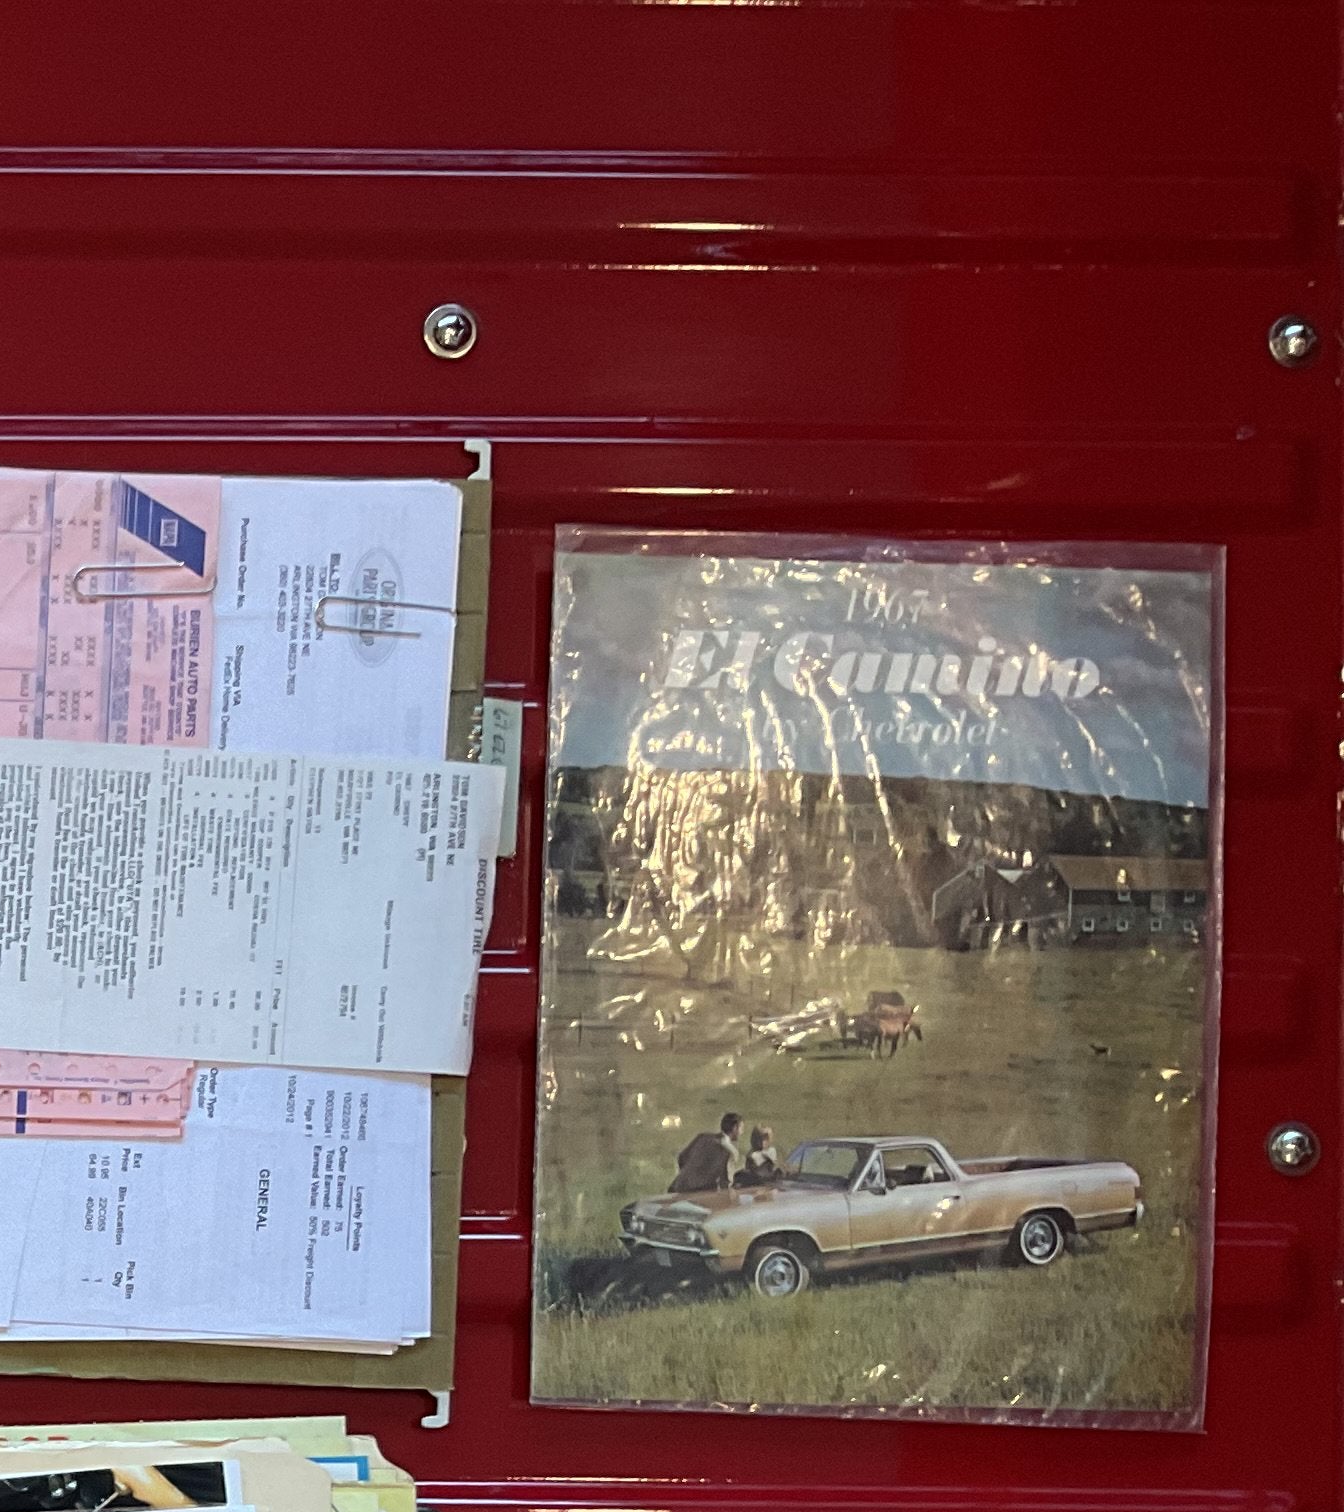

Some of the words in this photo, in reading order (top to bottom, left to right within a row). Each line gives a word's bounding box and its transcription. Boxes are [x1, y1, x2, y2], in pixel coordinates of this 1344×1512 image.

[239, 518, 250, 562] Purchase
[238, 565, 248, 592] Order
[842, 588, 930, 624] 1967
[189, 610, 201, 657] BURIEN
[187, 661, 199, 694] AUTO
[232, 645, 245, 687] Shipping
[663, 629, 760, 689] El
[773, 629, 1101, 699] Camino
[184, 698, 197, 738] PARTS
[217, 715, 230, 751] Delivery
[473, 858, 488, 923] DISCOUNT
[195, 1074, 208, 1109] Regular
[207, 1067, 219, 1094] Order
[204, 1095, 217, 1118] Type
[310, 1145, 322, 1178] Earned
[324, 1149, 335, 1172] Total
[337, 1145, 348, 1172] Order
[256, 1169, 270, 1232] GENERAL
[322, 1174, 333, 1210] Earned:
[335, 1175, 347, 1211] Earned:
[352, 1186, 365, 1220] Loyalty
[114, 1204, 125, 1245] Location
[352, 1222, 363, 1251] Points
